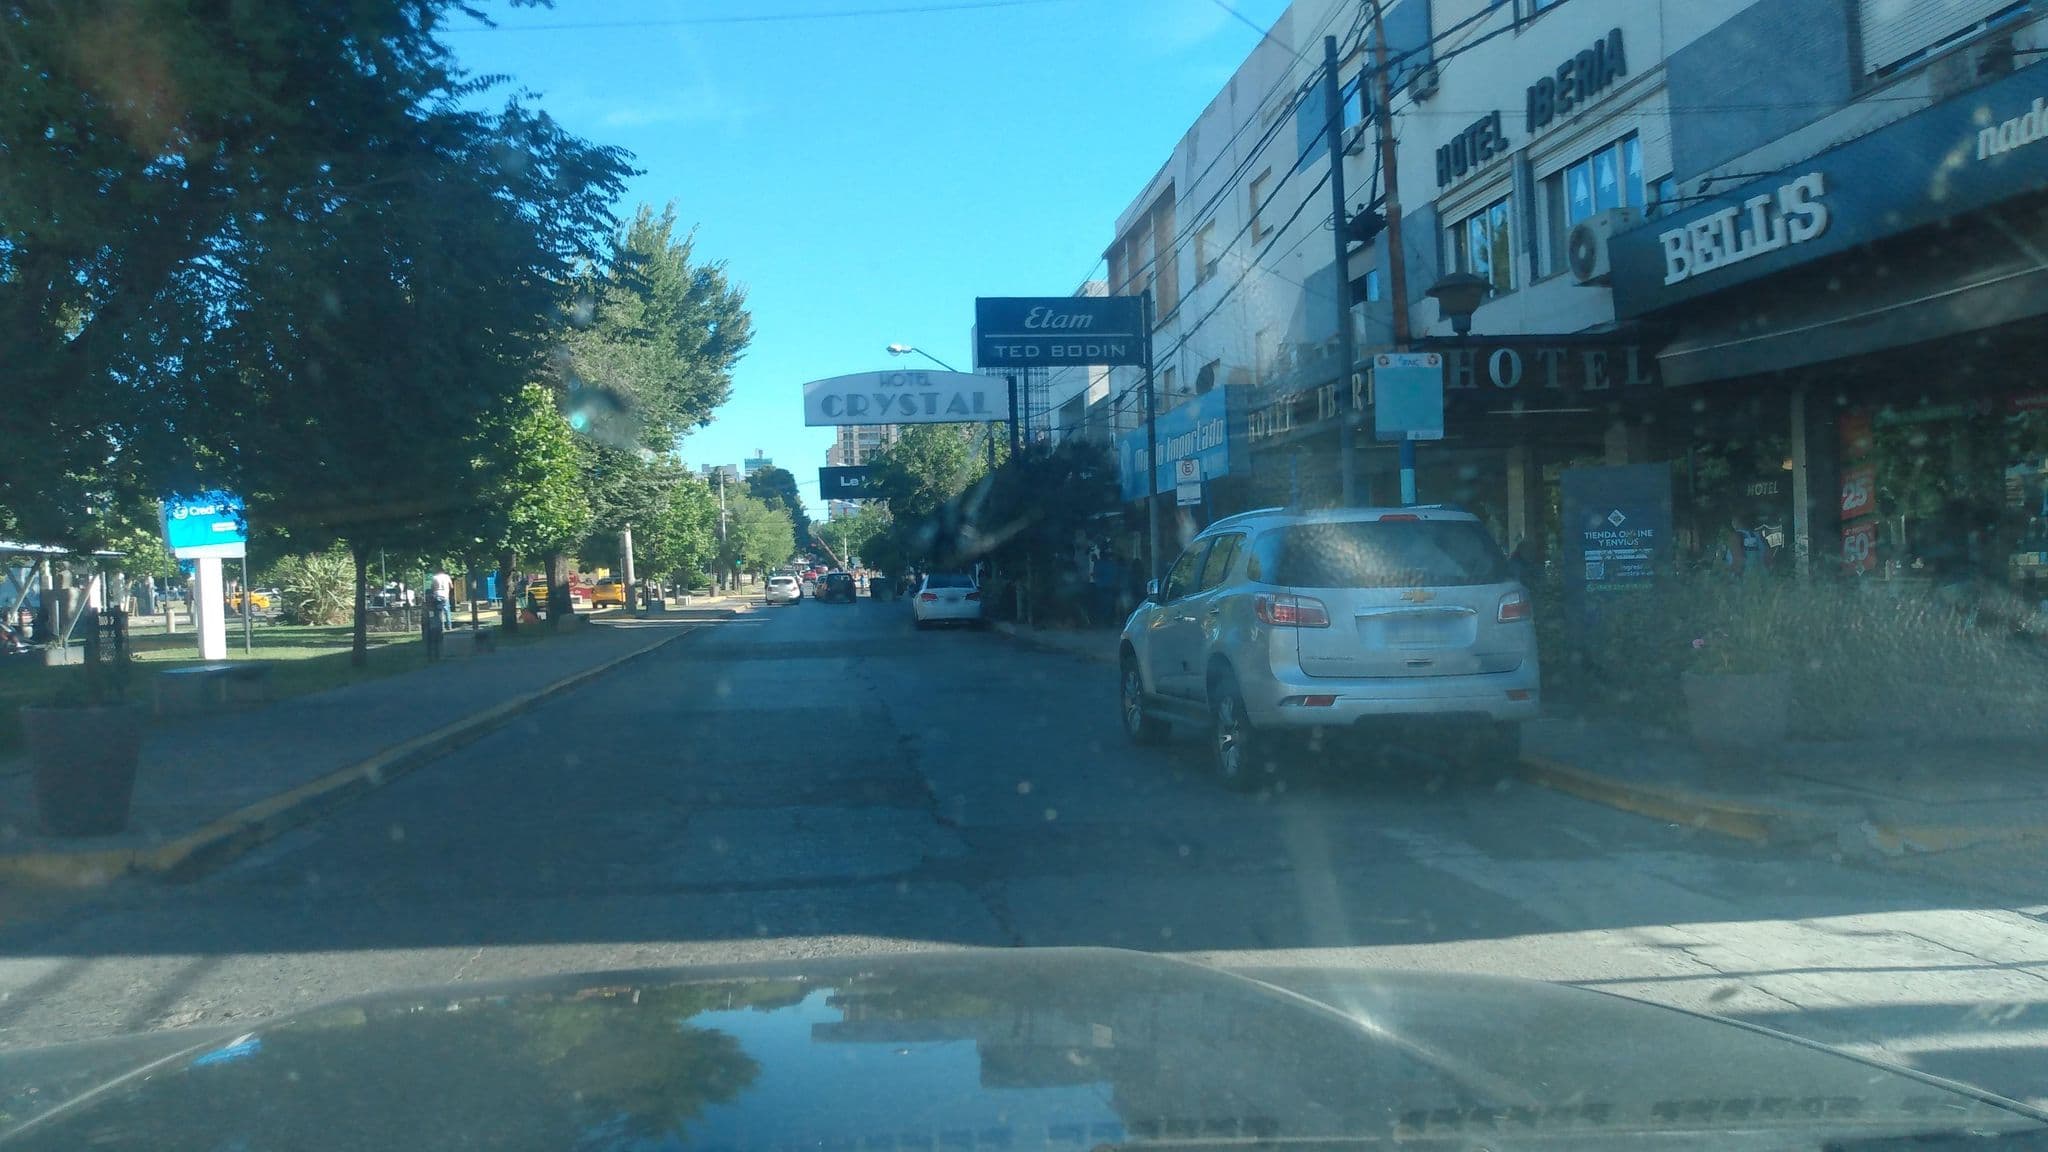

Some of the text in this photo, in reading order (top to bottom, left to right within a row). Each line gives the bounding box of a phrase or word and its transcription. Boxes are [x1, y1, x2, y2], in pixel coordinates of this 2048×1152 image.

[1436, 27, 1627, 188] HOTEL IBERIA
[1977, 96, 2048, 161] nad
[1024, 306, 1094, 329] Etam
[994, 345, 1126, 358] TED BODIN
[1447, 346, 1653, 390] HOTEL
[880, 373, 933, 387] HOTEL
[821, 391, 992, 418] CRYSTAL
[1747, 481, 1779, 496] HOTEL
[1584, 532, 1617, 540] TIENDA
